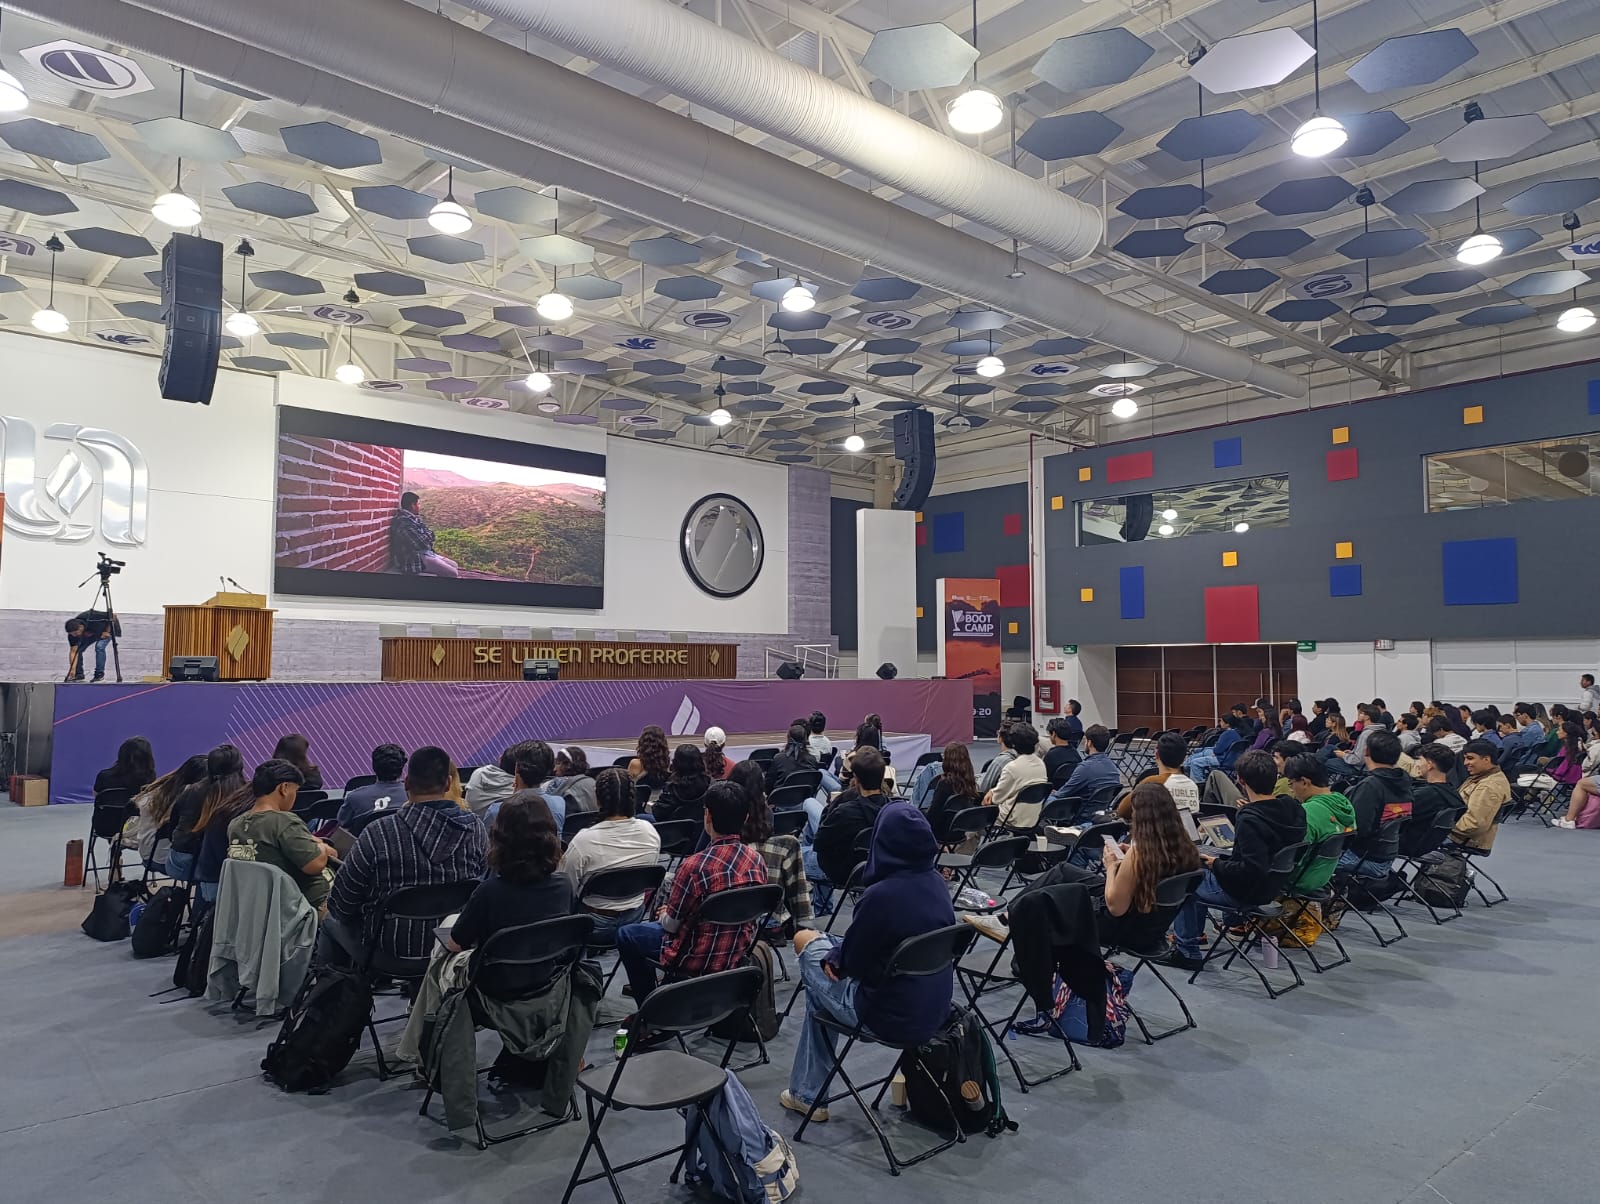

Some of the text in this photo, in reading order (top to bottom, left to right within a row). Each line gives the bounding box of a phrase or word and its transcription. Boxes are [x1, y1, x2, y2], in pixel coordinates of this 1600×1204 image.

[965, 614, 992, 623] BOOT
[965, 623, 994, 632] CAMP
[474, 647, 503, 664] SE
[590, 648, 689, 665] PROFERRE
